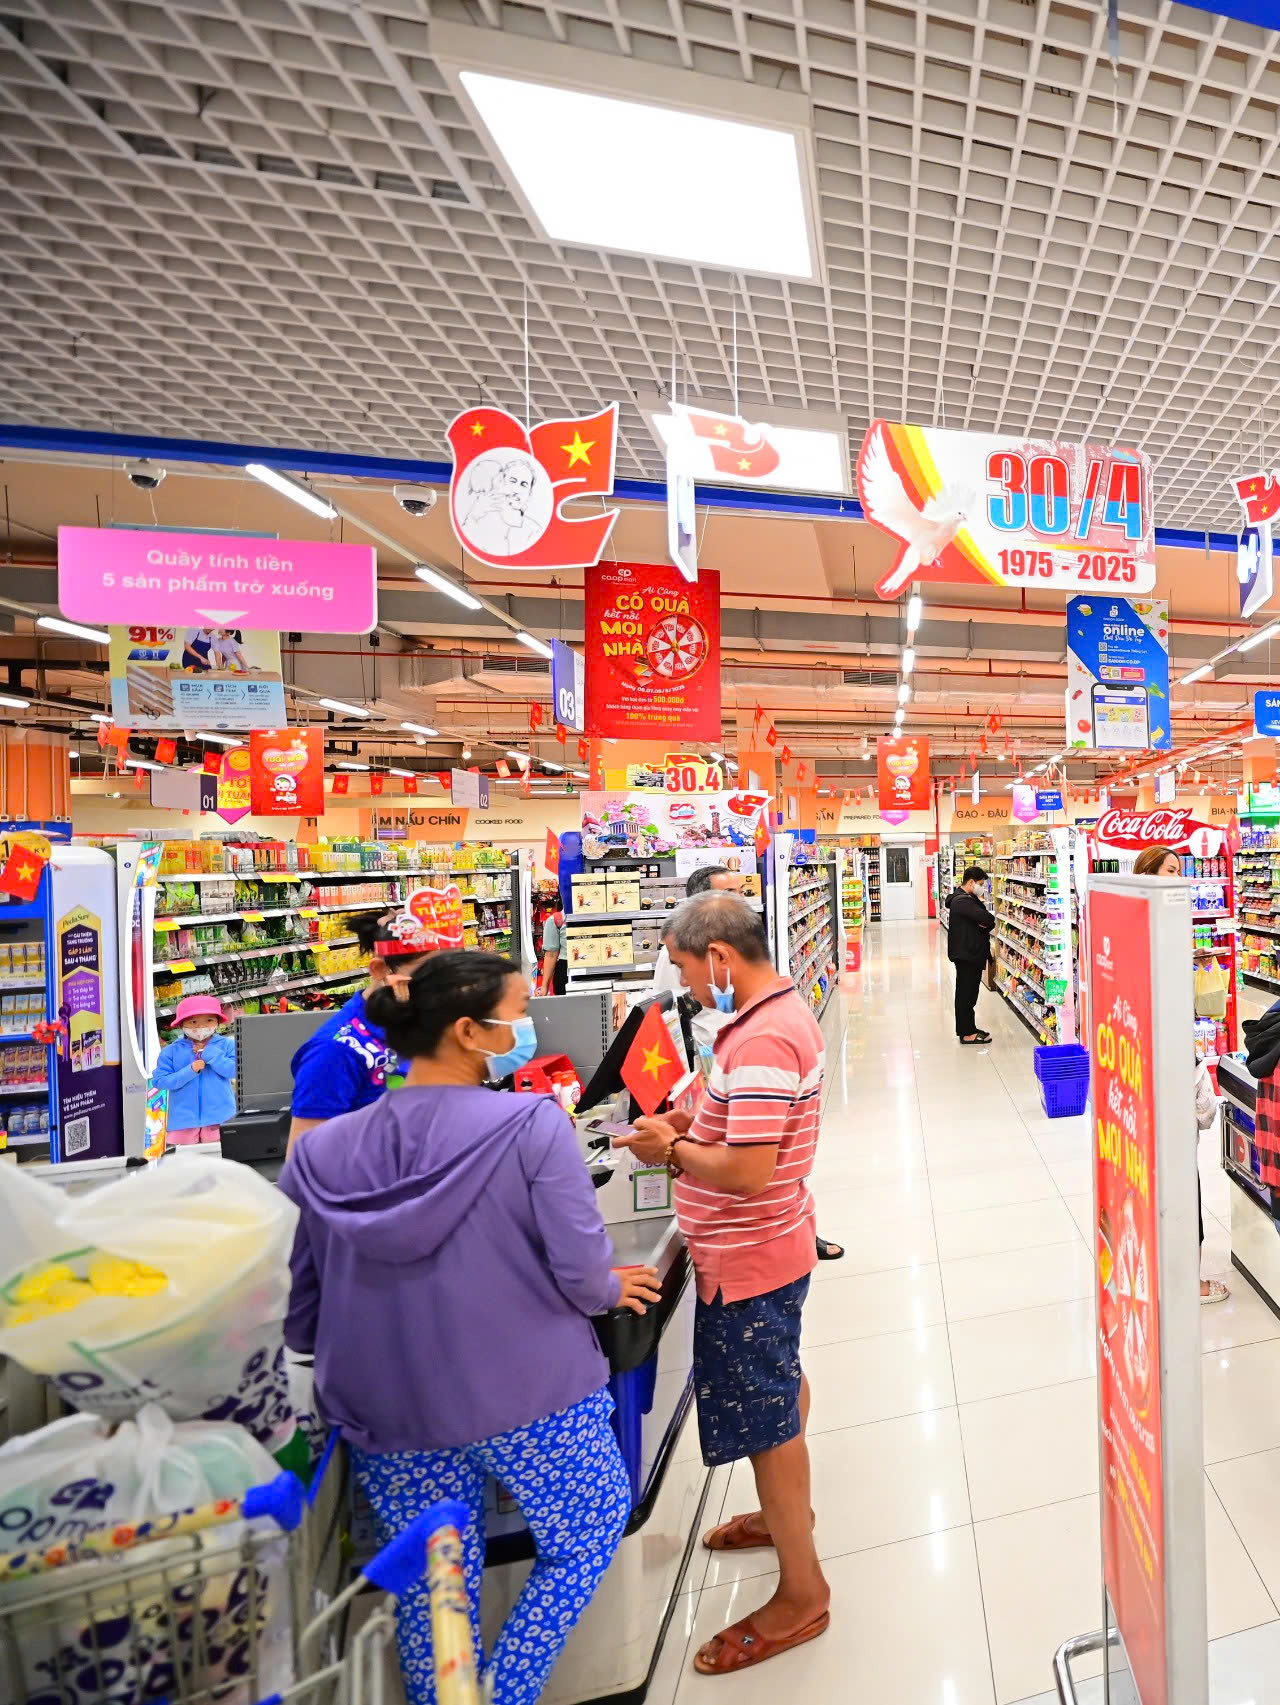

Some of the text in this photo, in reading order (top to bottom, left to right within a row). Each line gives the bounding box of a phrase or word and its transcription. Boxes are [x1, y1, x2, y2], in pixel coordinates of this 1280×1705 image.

[986, 451, 1143, 540] 30/4
[147, 548, 293, 572] Quầy tính tiền
[998, 549, 1053, 577] 1975
[1077, 554, 1136, 582] 2025
[103, 572, 335, 601] 5 sản phẩm trở xuống
[616, 592, 690, 615] CÓ QUÀ
[603, 608, 622, 618] kết
[128, 625, 176, 642] 91%
[600, 620, 643, 638] MỌI
[1103, 624, 1145, 637] online
[603, 638, 644, 656] NHÀ
[559, 687, 575, 721] 03
[626, 712, 647, 720] 100%
[666, 766, 720, 793] 30.4
[203, 794, 214, 809] 01
[480, 794, 488, 808] 02
[395, 813, 424, 826] NẤU
[428, 813, 461, 826] CHÍN
[956, 810, 978, 820] GẠO
[988, 809, 1008, 820] ĐẬU
[64, 957, 75, 965] SAU
[1097, 1013, 1144, 1102] CÓ QUÀ
[1097, 1117, 1149, 1206] MỌI NHÀ
